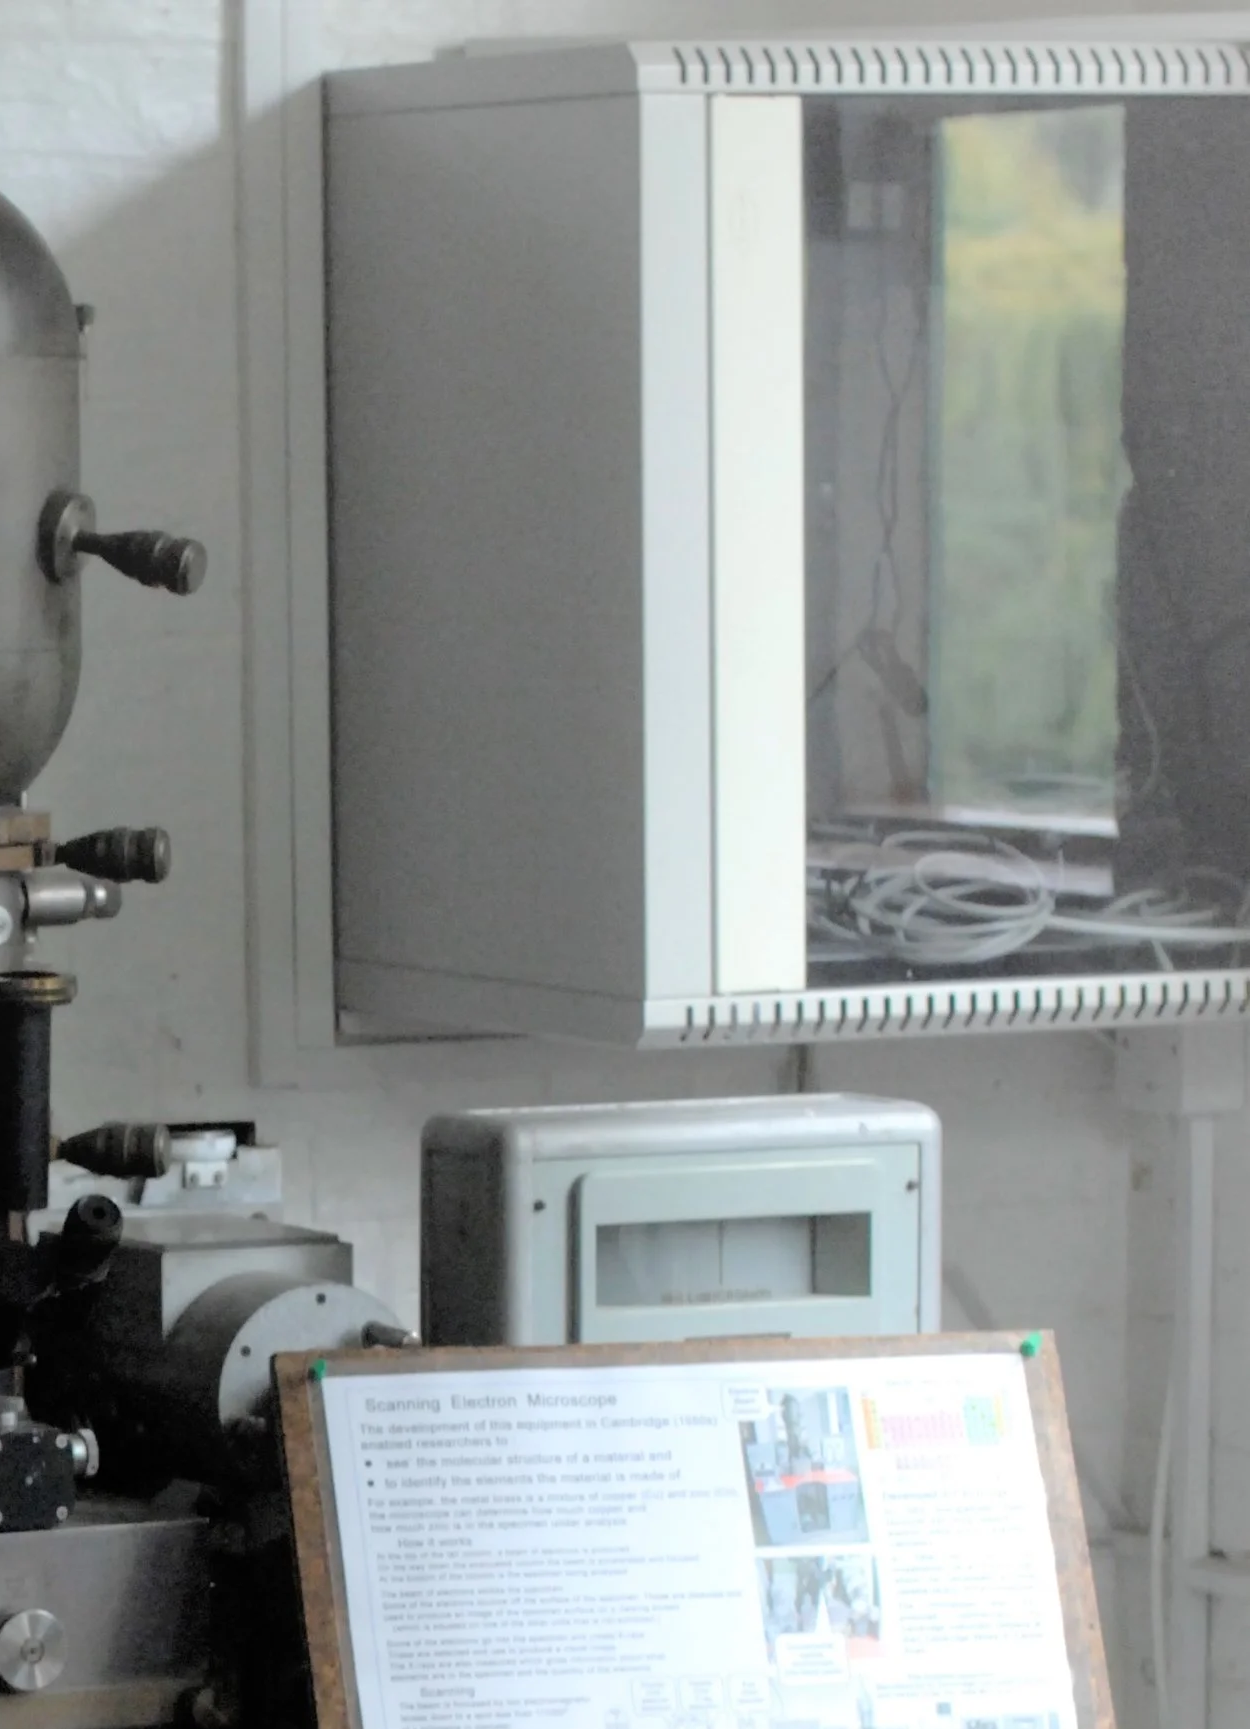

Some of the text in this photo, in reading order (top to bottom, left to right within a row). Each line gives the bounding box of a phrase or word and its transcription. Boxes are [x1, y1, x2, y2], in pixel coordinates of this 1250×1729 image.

[365, 1391, 616, 1414] Scanning Electron Microscope
